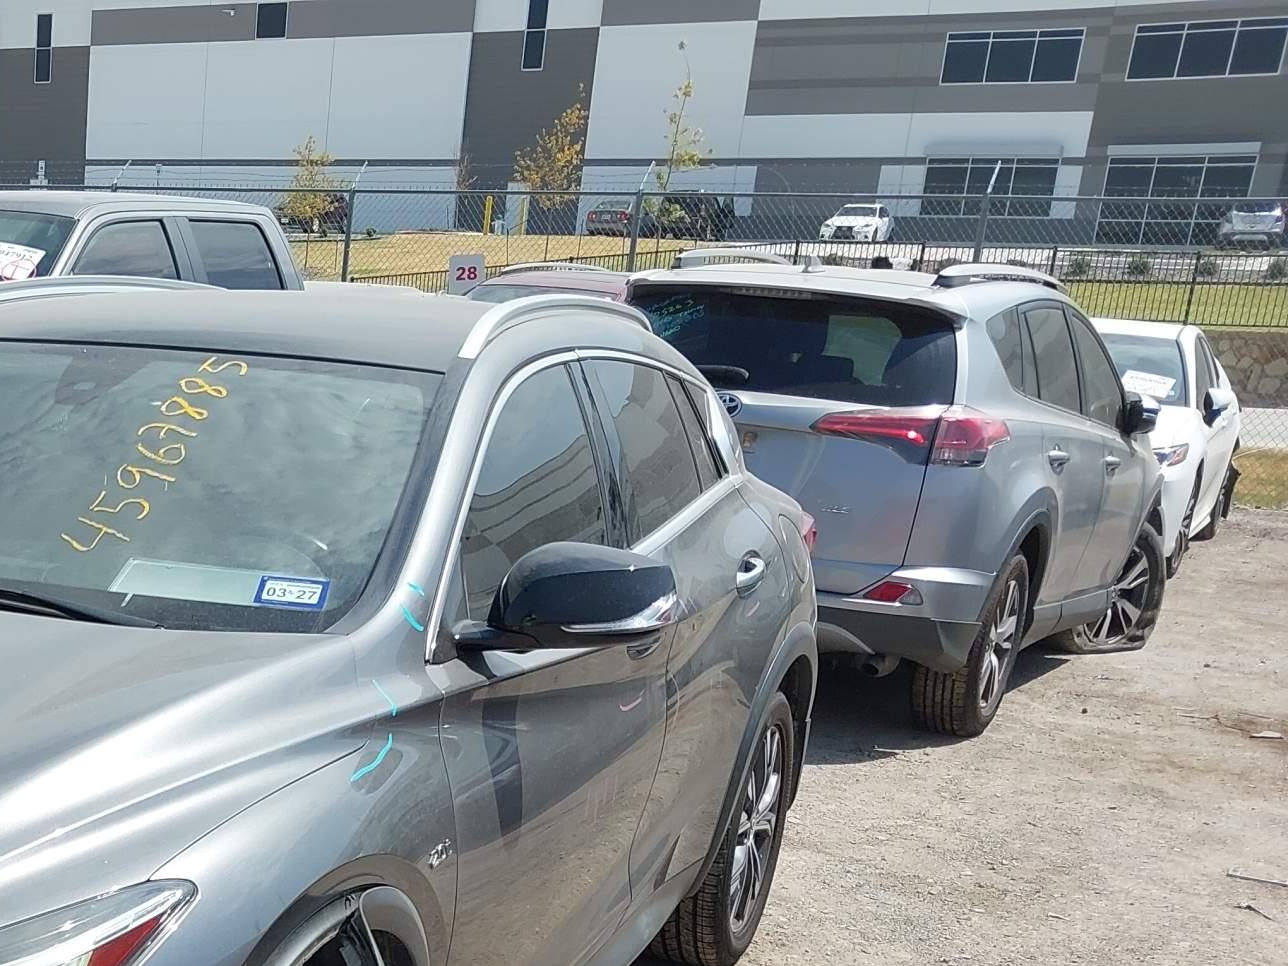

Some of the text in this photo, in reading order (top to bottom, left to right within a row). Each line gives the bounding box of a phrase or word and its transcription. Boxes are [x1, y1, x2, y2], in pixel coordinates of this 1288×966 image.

[455, 266, 478, 280] 28
[61, 357, 248, 552] 45967885
[266, 587, 317, 600] 03 27
